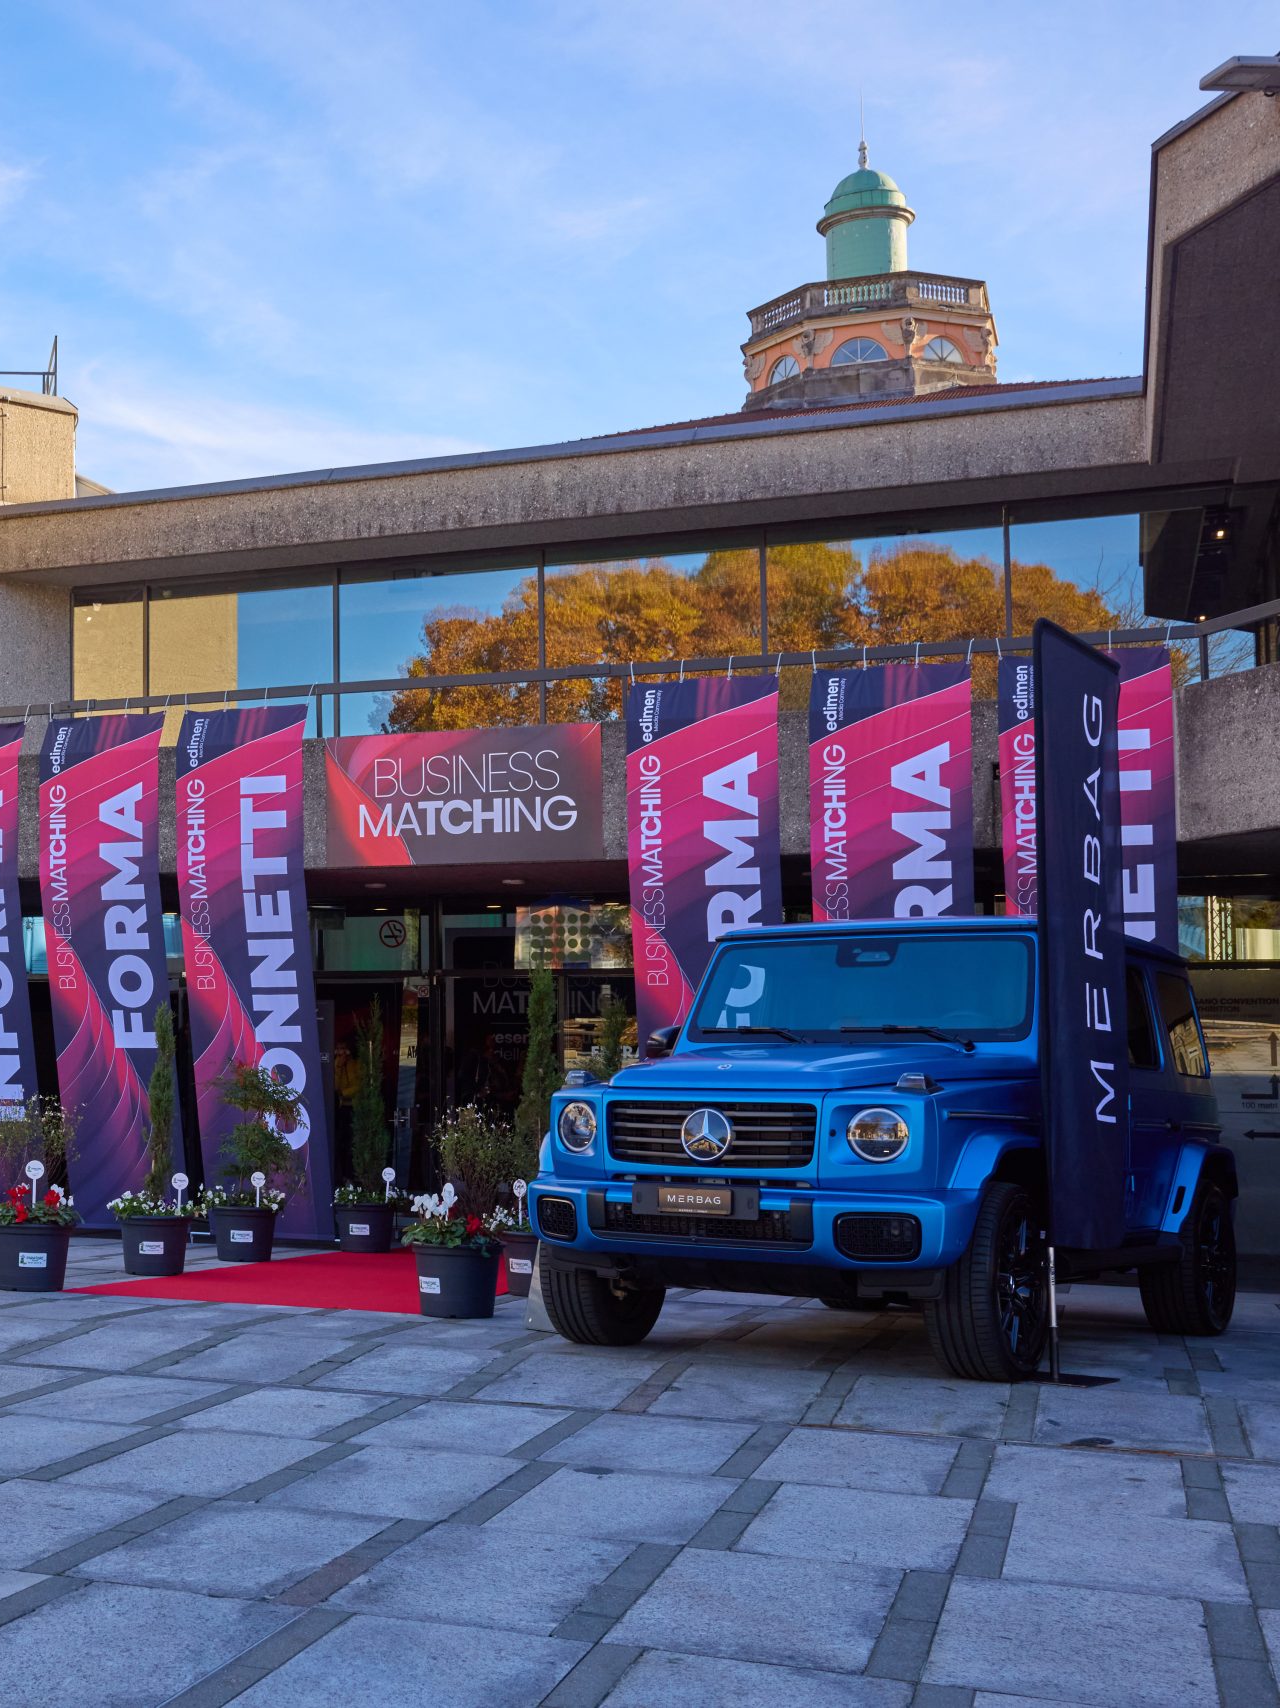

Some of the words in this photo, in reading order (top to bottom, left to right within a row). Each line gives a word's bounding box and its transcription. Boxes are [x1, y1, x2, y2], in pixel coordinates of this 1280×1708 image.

[639, 689, 656, 743] edimen
[822, 677, 839, 732] edimen
[1013, 665, 1028, 720] edimen
[49, 727, 68, 774] edimen
[187, 718, 204, 767] edimen
[374, 750, 560, 798] BUSINESS
[358, 795, 578, 838] MATCHING
[1083, 693, 1117, 1124] MERBAG
[667, 1194, 721, 1205] MERBAG
